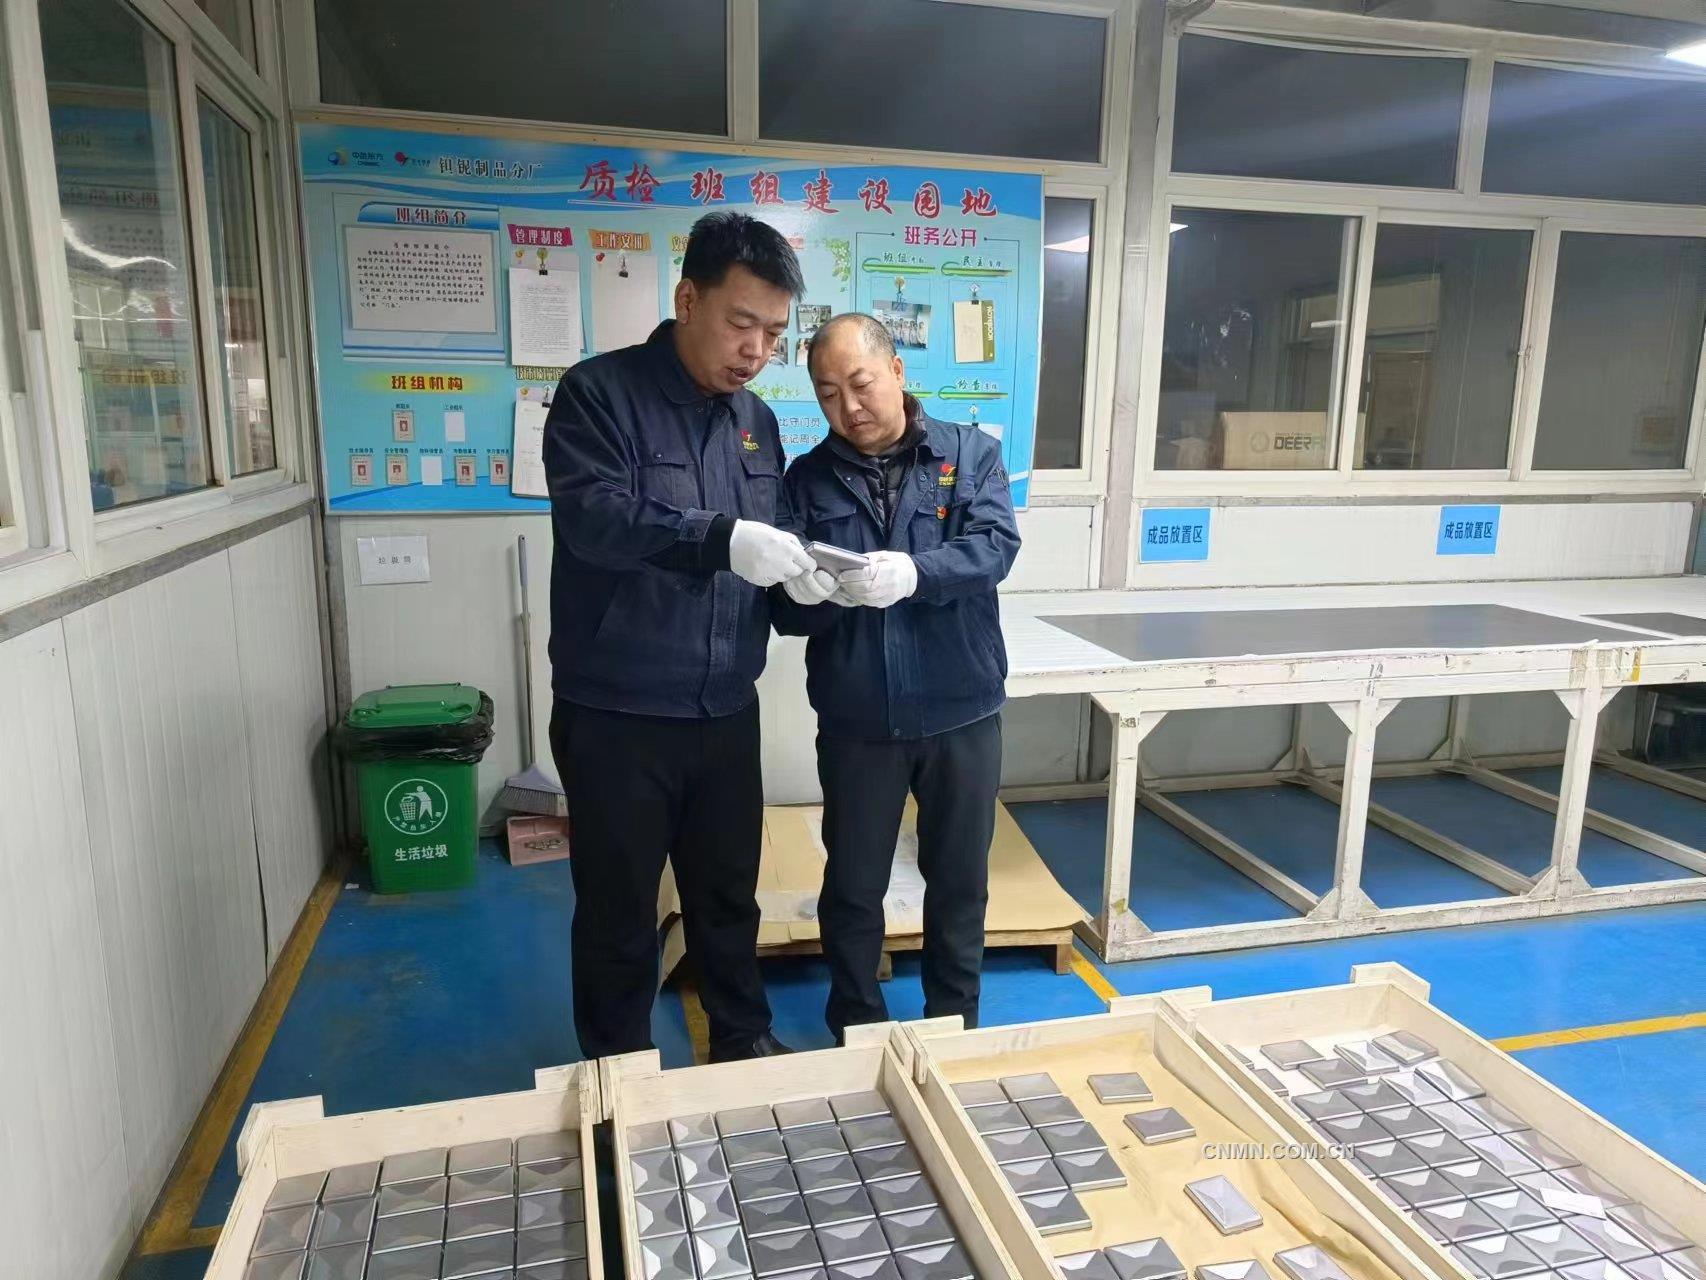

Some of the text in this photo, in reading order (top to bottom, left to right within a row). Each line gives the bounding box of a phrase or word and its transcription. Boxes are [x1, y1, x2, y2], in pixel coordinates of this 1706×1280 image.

[579, 160, 998, 219] 质检 班组建设园地
[396, 207, 467, 224] 班组简介
[515, 228, 564, 246] 管理制度
[904, 226, 977, 247] 班务公开
[391, 376, 463, 390] 班组机构
[1147, 525, 1203, 544] 成品放置区
[1445, 521, 1493, 539] 成品放置区
[394, 844, 449, 862] 生活垃圾
